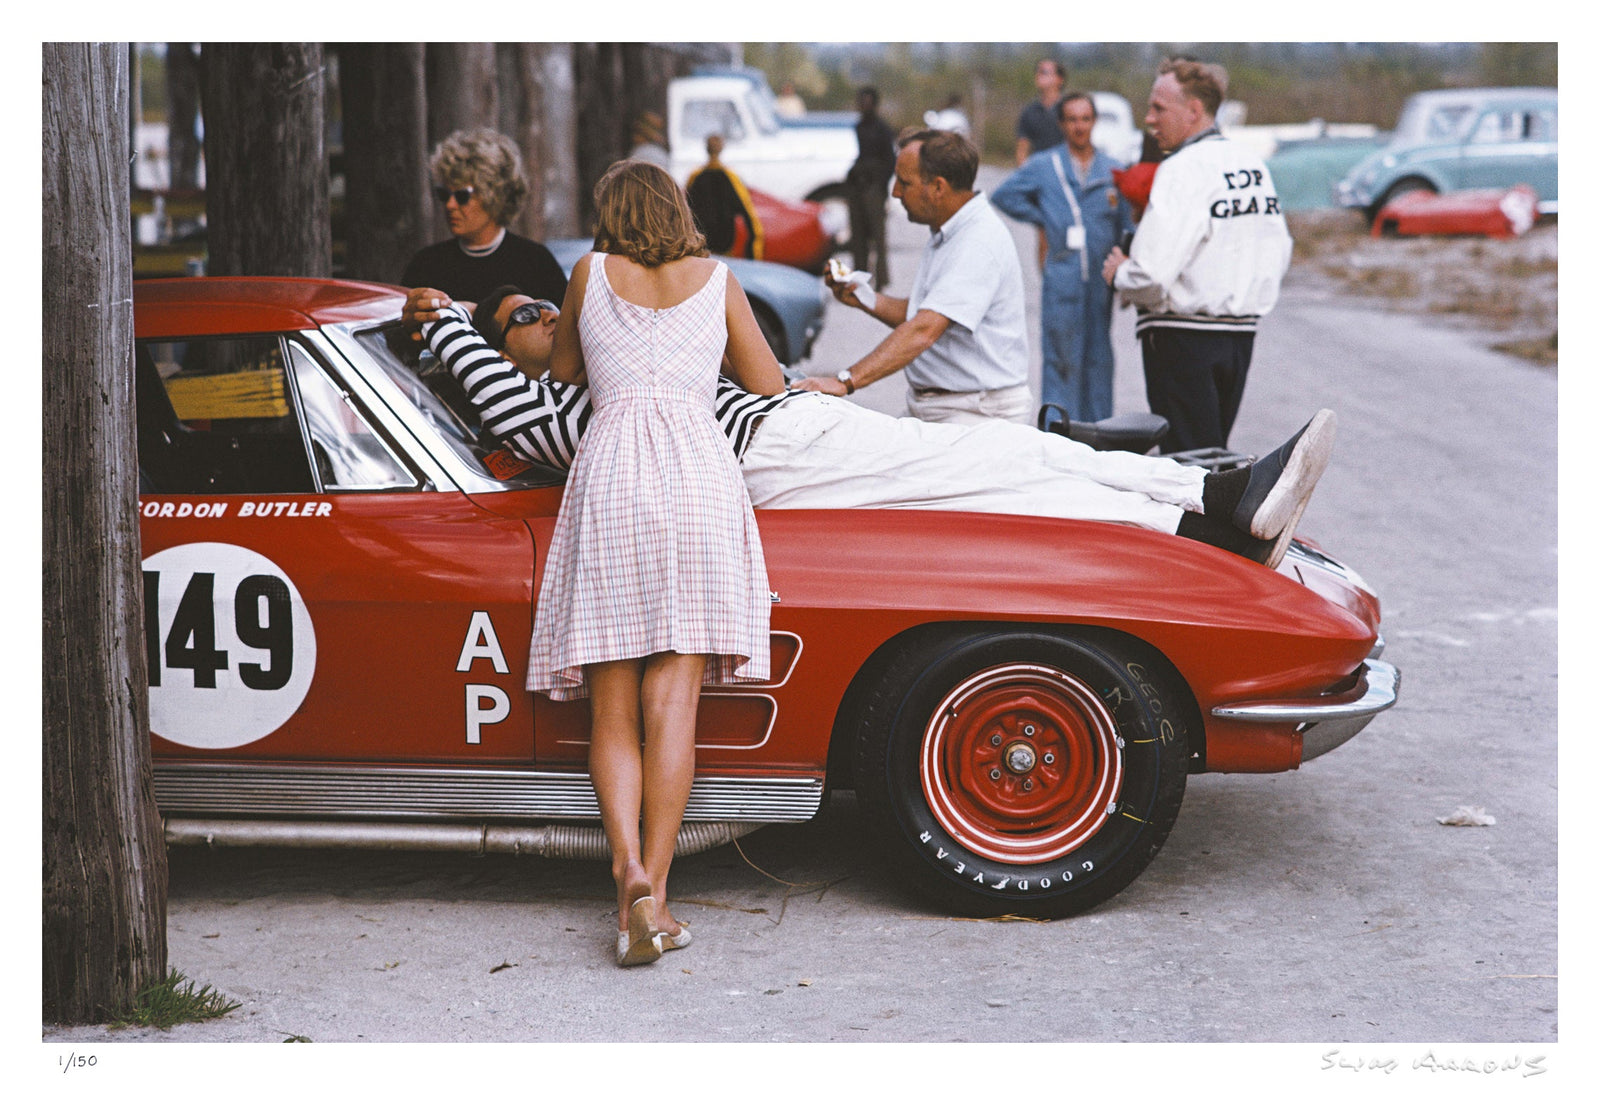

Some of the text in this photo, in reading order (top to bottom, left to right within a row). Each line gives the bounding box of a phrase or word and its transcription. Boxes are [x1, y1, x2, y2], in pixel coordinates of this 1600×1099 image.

[1210, 196, 1280, 219] GEAR
[139, 502, 332, 518] ORDON BUTLER
[143, 570, 293, 690] 149
[455, 609, 511, 674] A
[464, 683, 512, 745] P
[919, 830, 1095, 890] GOODYEAR
